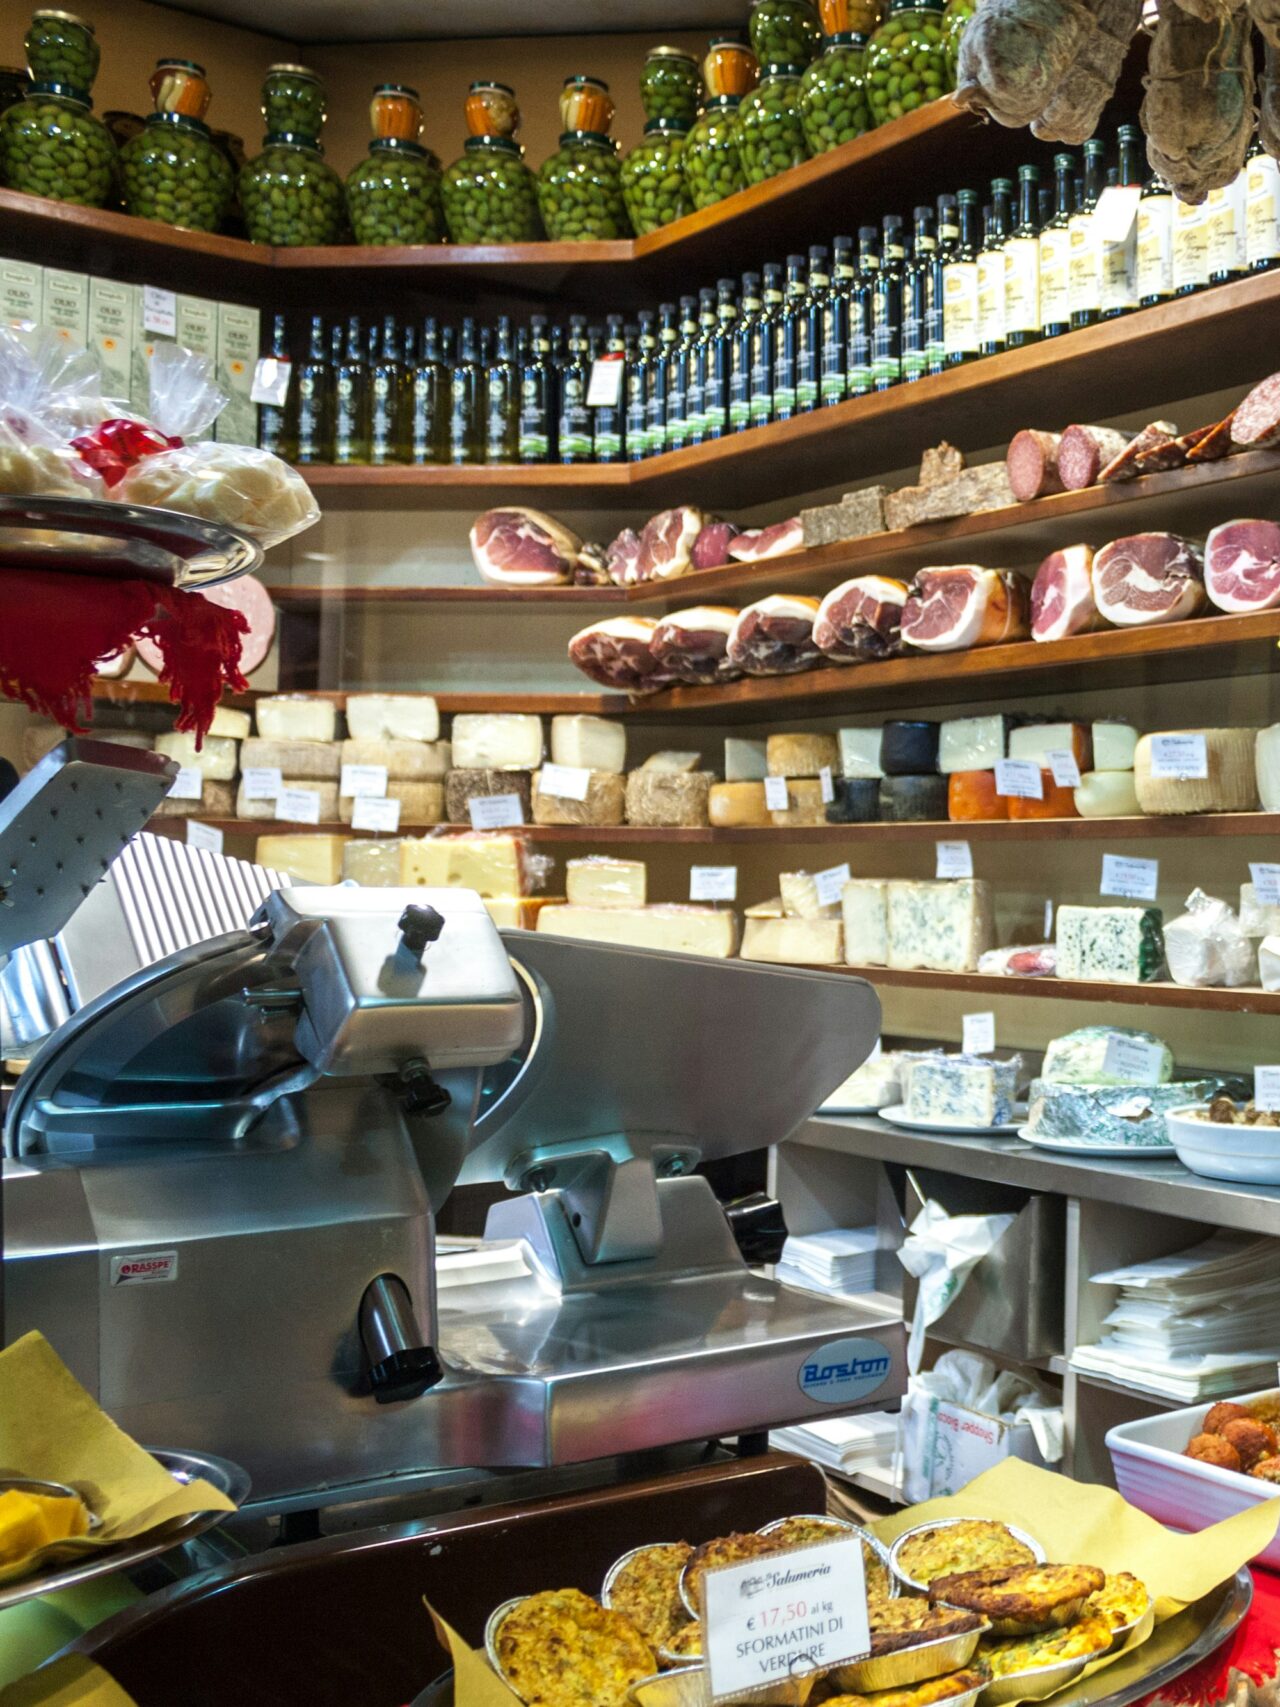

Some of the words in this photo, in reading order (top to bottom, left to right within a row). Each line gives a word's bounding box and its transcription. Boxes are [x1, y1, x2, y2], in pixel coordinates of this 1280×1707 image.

[131, 1261, 169, 1273] RASSPE
[803, 1357, 890, 1383] Boston
[766, 1563, 832, 1589] Salumeria
[760, 1601, 808, 1628] 17,50
[822, 1601, 833, 1613] kg
[736, 1622, 825, 1658] SFORMATINI
[828, 1616, 843, 1634] DI
